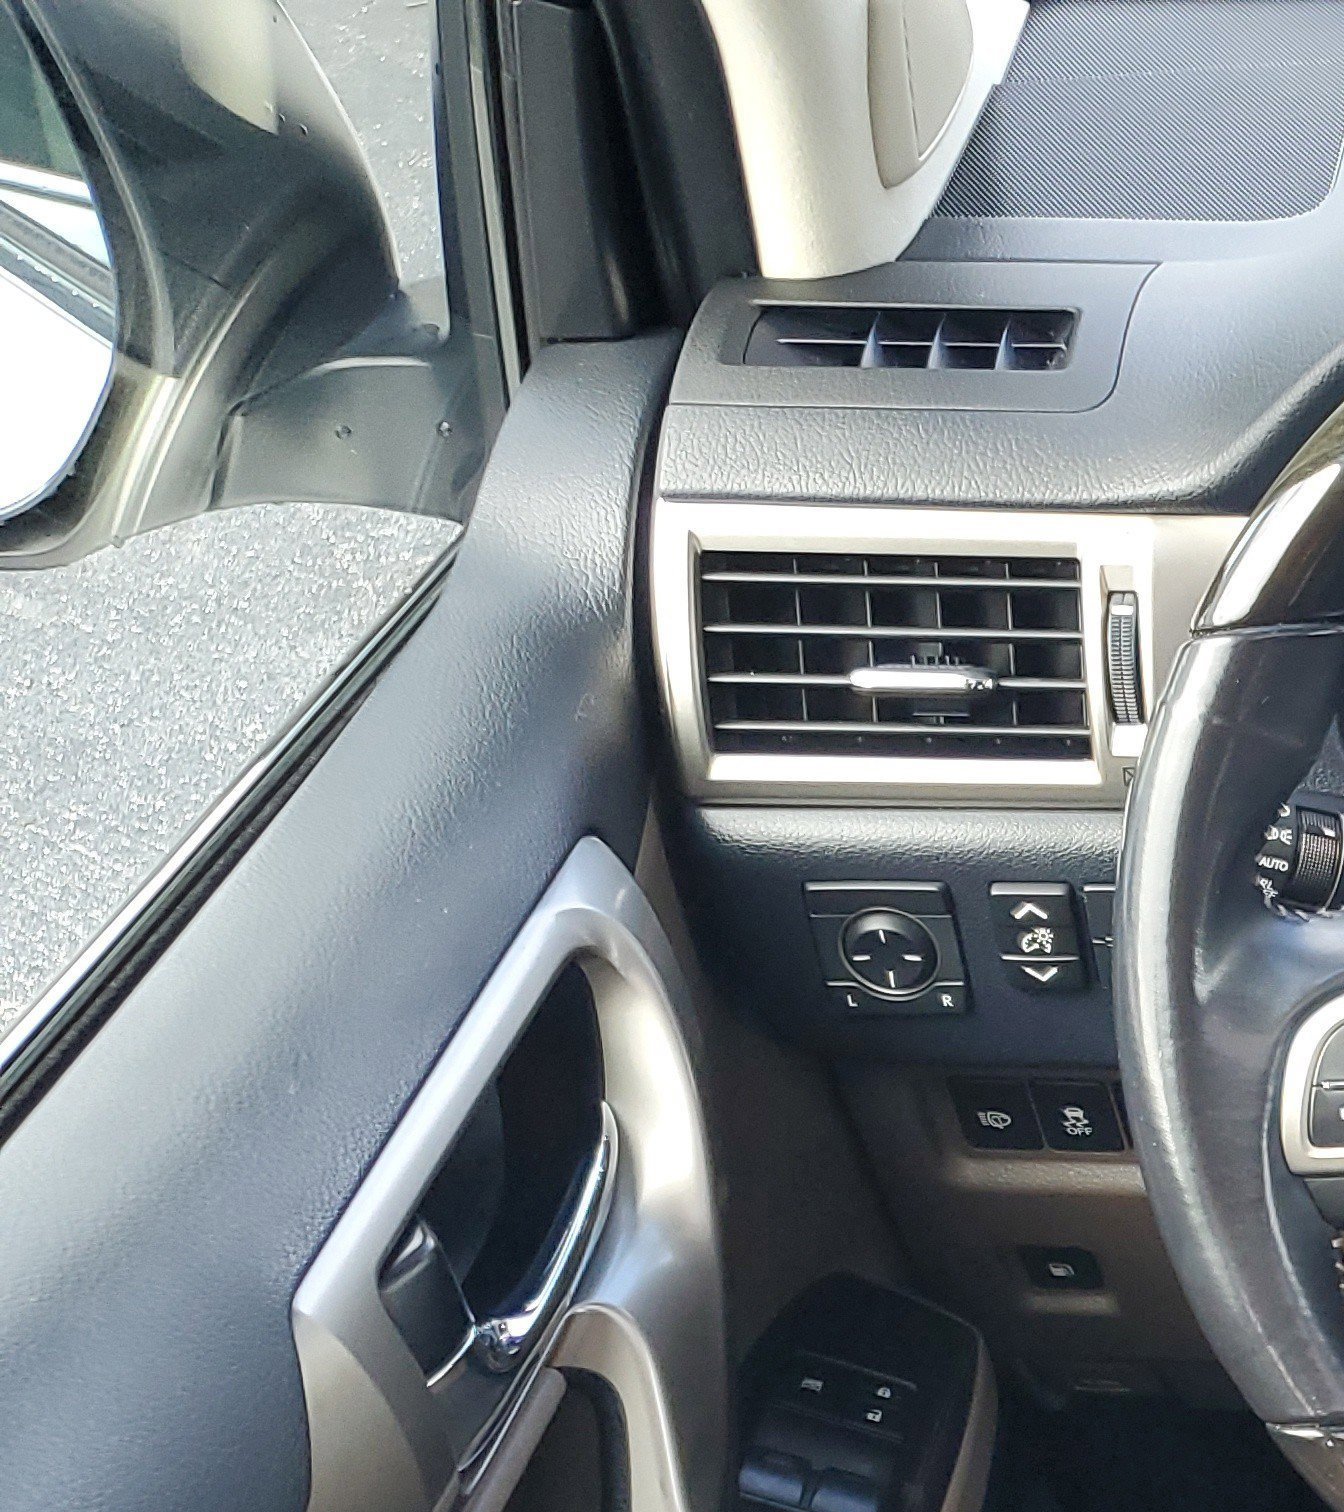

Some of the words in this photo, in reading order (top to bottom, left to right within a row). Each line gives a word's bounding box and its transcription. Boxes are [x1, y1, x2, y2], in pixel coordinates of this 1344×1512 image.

[1258, 855, 1289, 873] AUTO
[846, 993, 858, 1008] L
[941, 994, 954, 1008] R
